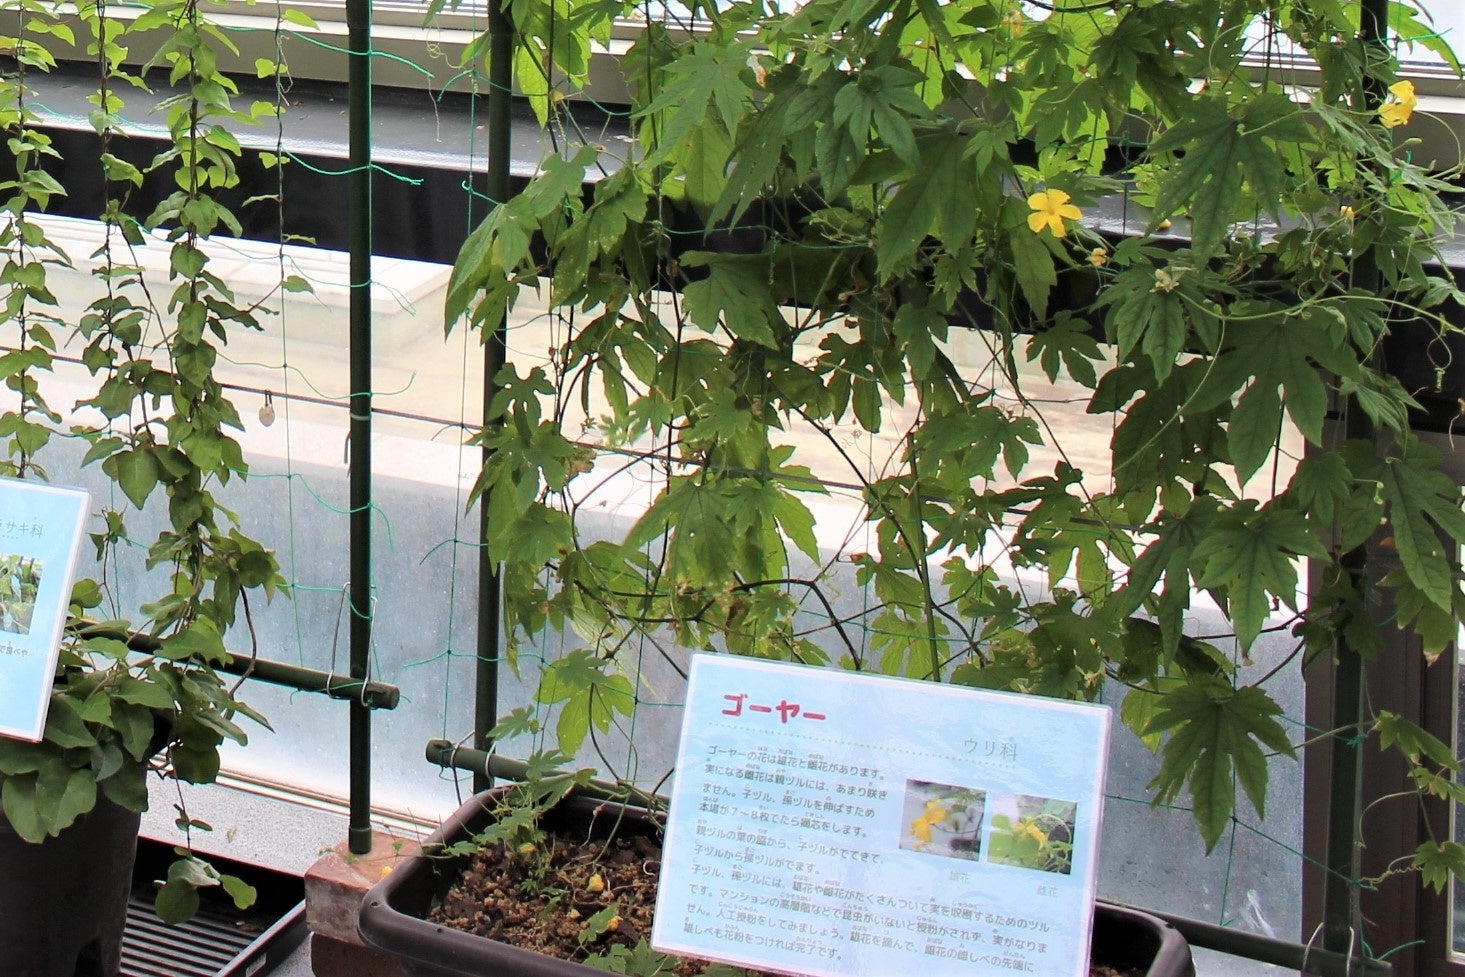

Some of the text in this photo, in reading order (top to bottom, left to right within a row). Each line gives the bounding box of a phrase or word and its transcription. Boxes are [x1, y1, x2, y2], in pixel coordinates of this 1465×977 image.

[722, 692, 826, 724] ゴーヤー
[963, 737, 1018, 761] ウリ科
